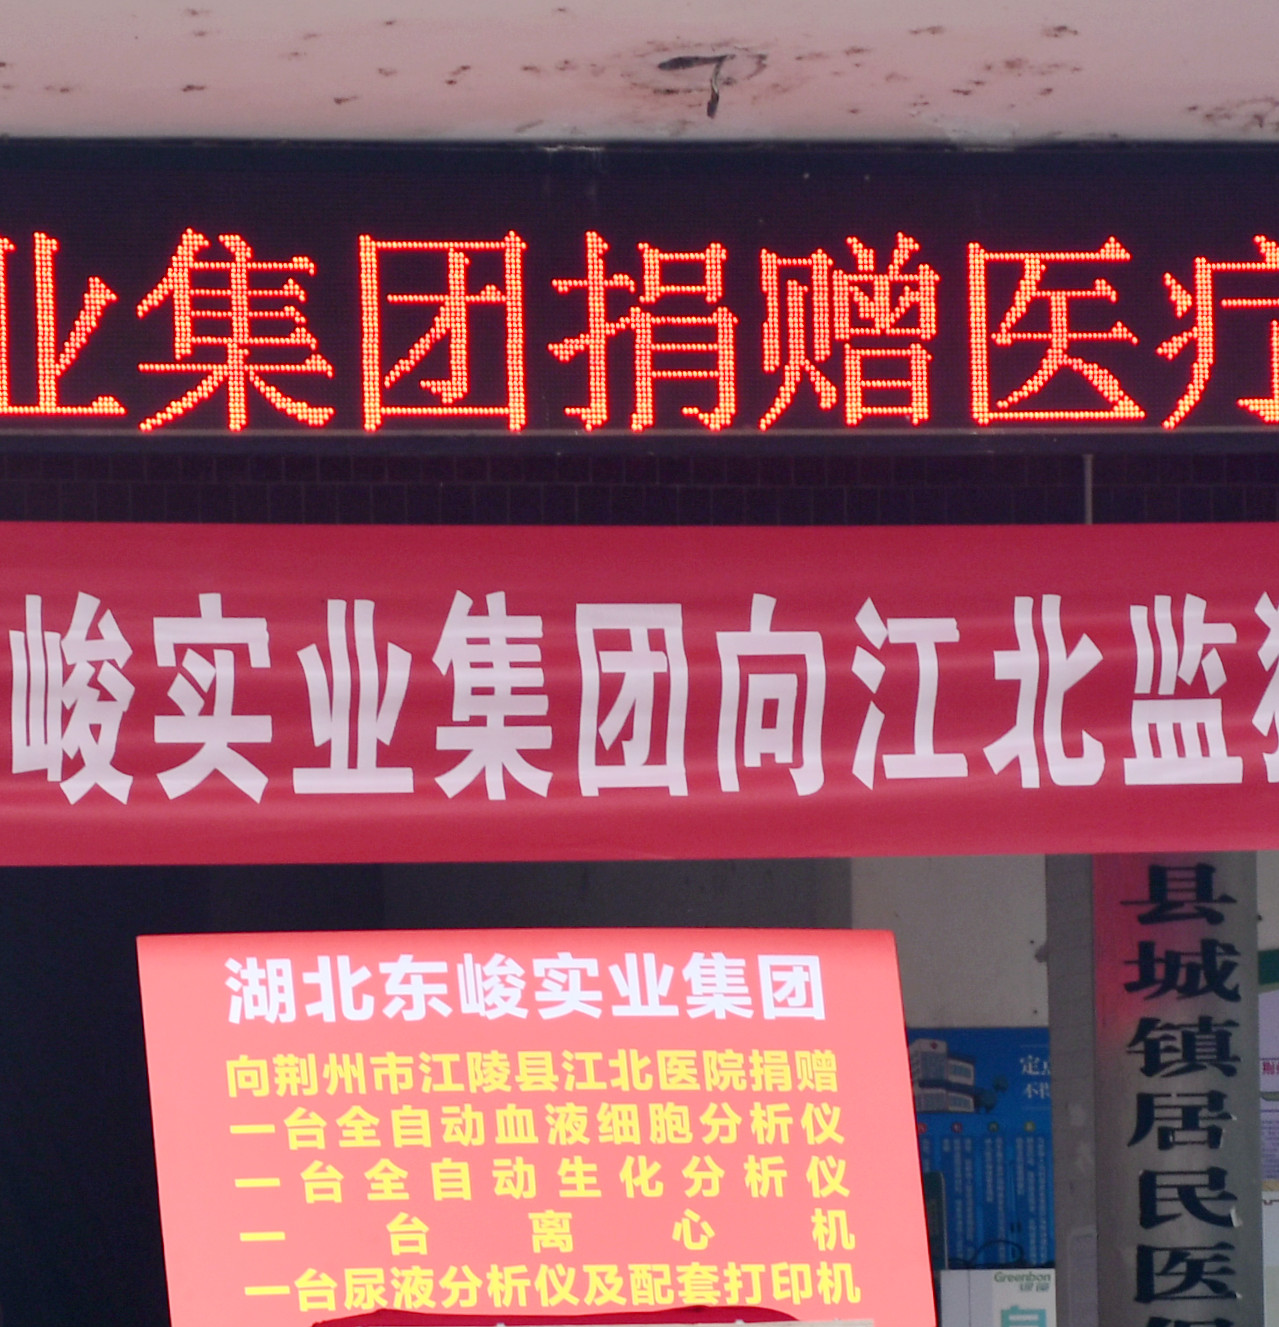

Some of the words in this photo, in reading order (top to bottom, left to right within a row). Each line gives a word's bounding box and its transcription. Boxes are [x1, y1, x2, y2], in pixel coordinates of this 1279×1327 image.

[225, 952, 826, 1025] 湖北东峻实业集团
[226, 1049, 839, 1099] 向荆州市江陵县江北医院捐赠
[230, 1102, 844, 1152] 一台全自动血液细胞分析仪
[235, 1156, 851, 1205] 一台全自动生化分析仪
[240, 1211, 856, 1257] 一台离心机
[245, 1262, 861, 1314] 一台尿液分析仪及配套打印机
